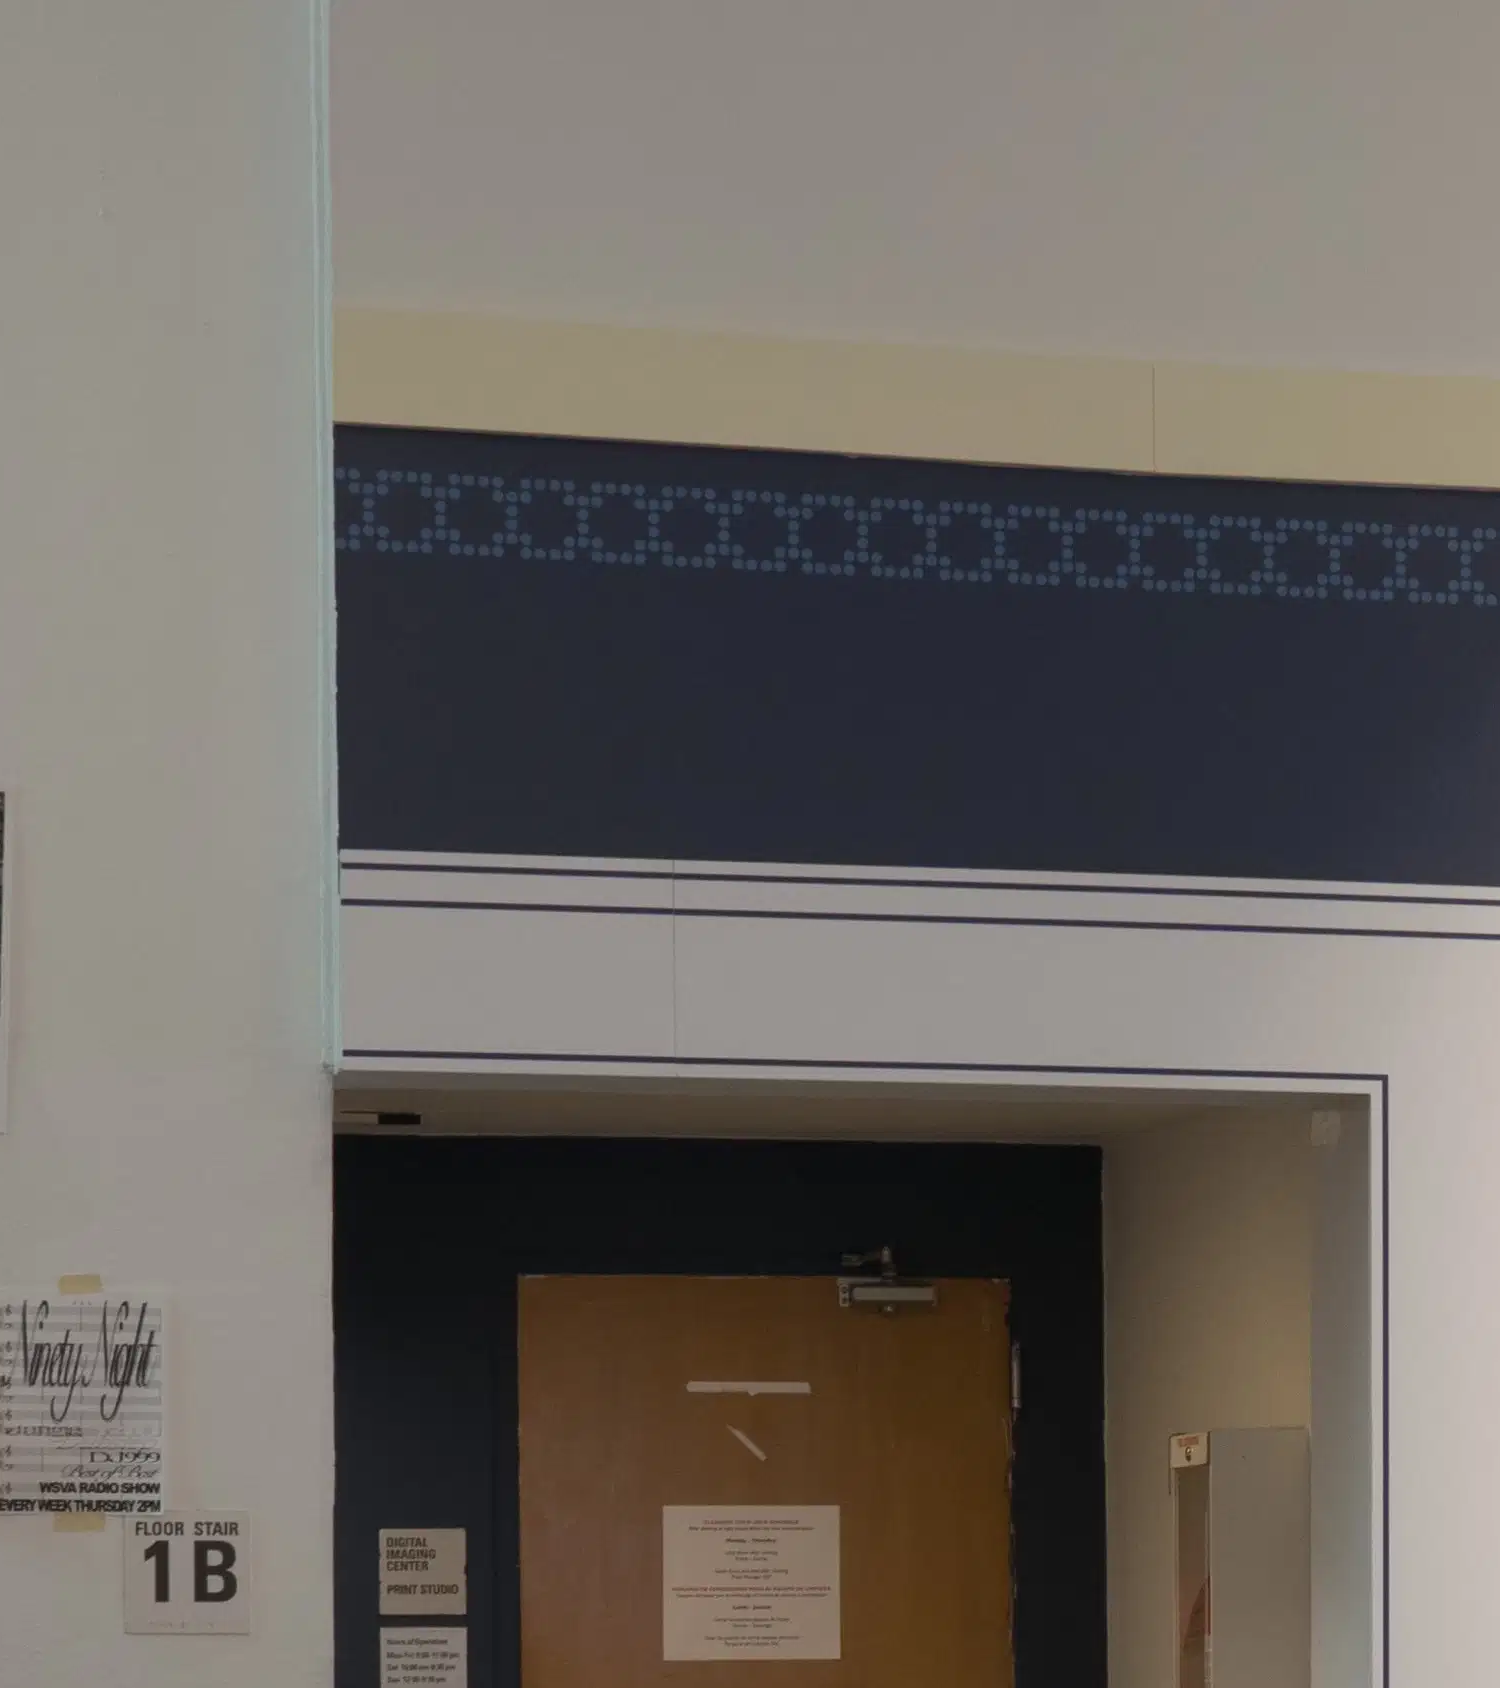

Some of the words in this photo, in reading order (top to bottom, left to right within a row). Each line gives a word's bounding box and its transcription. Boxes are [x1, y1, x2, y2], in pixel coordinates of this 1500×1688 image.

[39, 1482, 77, 1494] WSVA
[79, 1482, 119, 1494] RADIO
[121, 1482, 161, 1494] SHOW
[0, 1499, 37, 1512] EVERY
[38, 1499, 72, 1512] WEEK
[74, 1499, 135, 1512] THURSDAY
[137, 1499, 161, 1512] 2PM
[135, 1521, 185, 1536] FLOOR
[193, 1521, 240, 1536] STAIR
[385, 1537, 428, 1548] DIGITAL
[385, 1548, 437, 1559] IMAGING
[143, 1540, 170, 1603] 1
[193, 1540, 238, 1603] B
[386, 1560, 430, 1572] CENTER
[387, 1583, 418, 1595] PRINT
[420, 1583, 460, 1595] STUDIO
